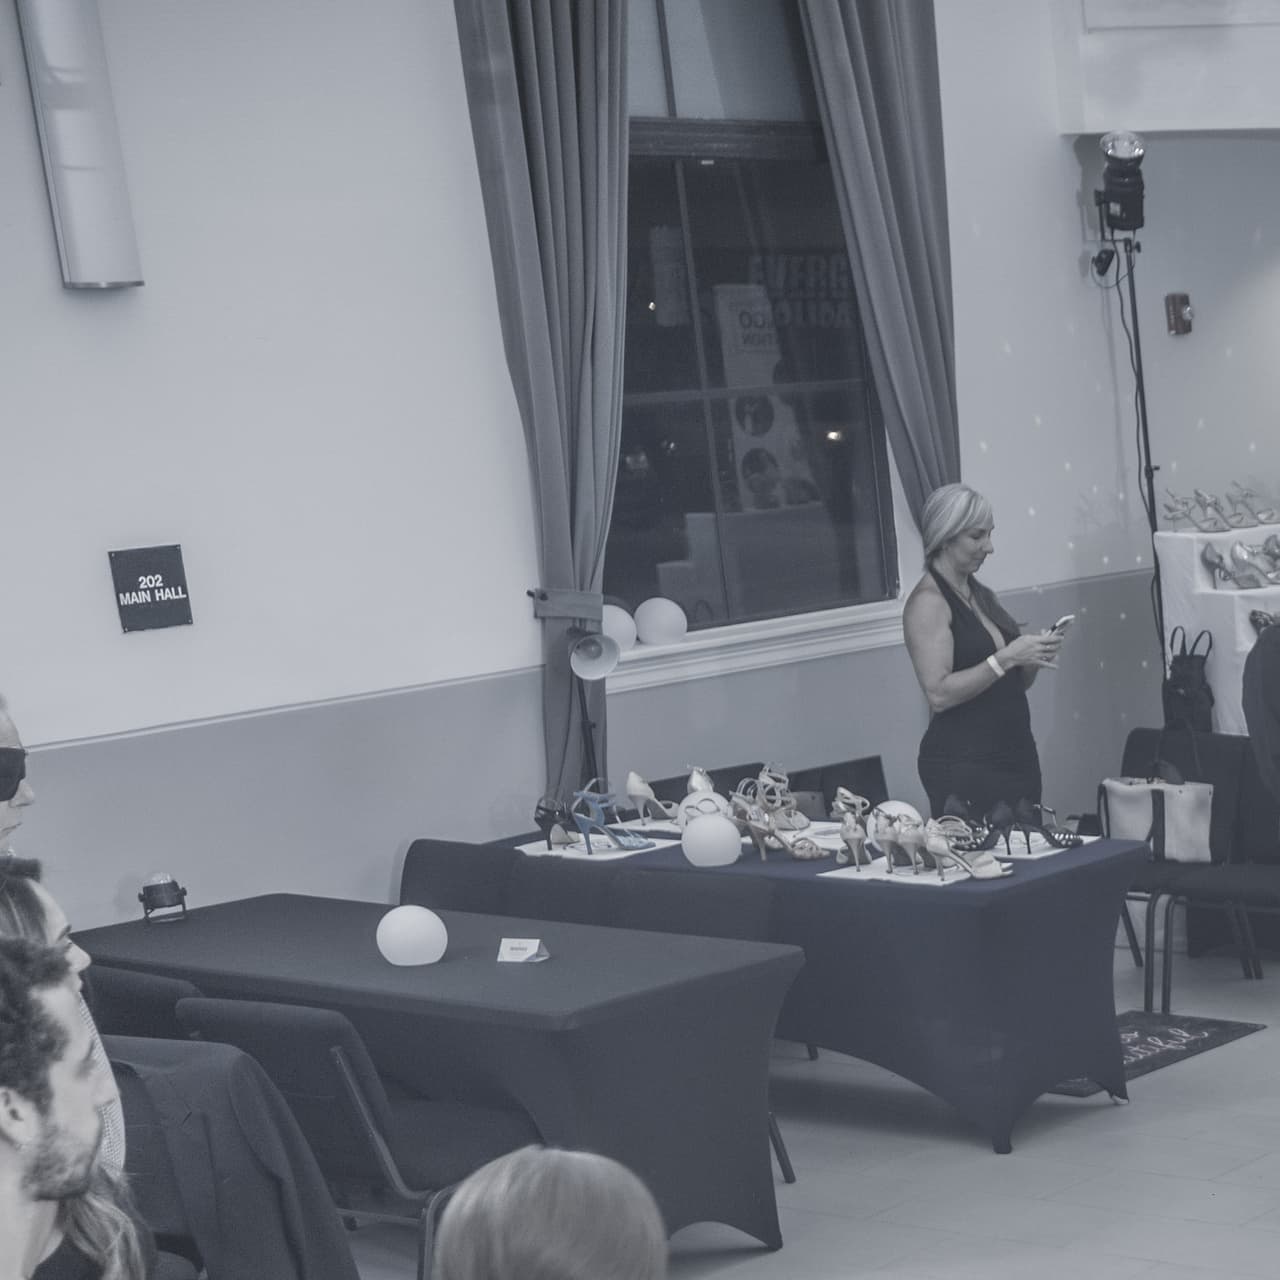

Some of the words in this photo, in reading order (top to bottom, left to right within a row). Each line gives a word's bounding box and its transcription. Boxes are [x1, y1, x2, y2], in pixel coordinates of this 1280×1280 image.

[138, 574, 163, 589] 202
[119, 590, 151, 606] MAIN
[155, 586, 187, 601] HALL
